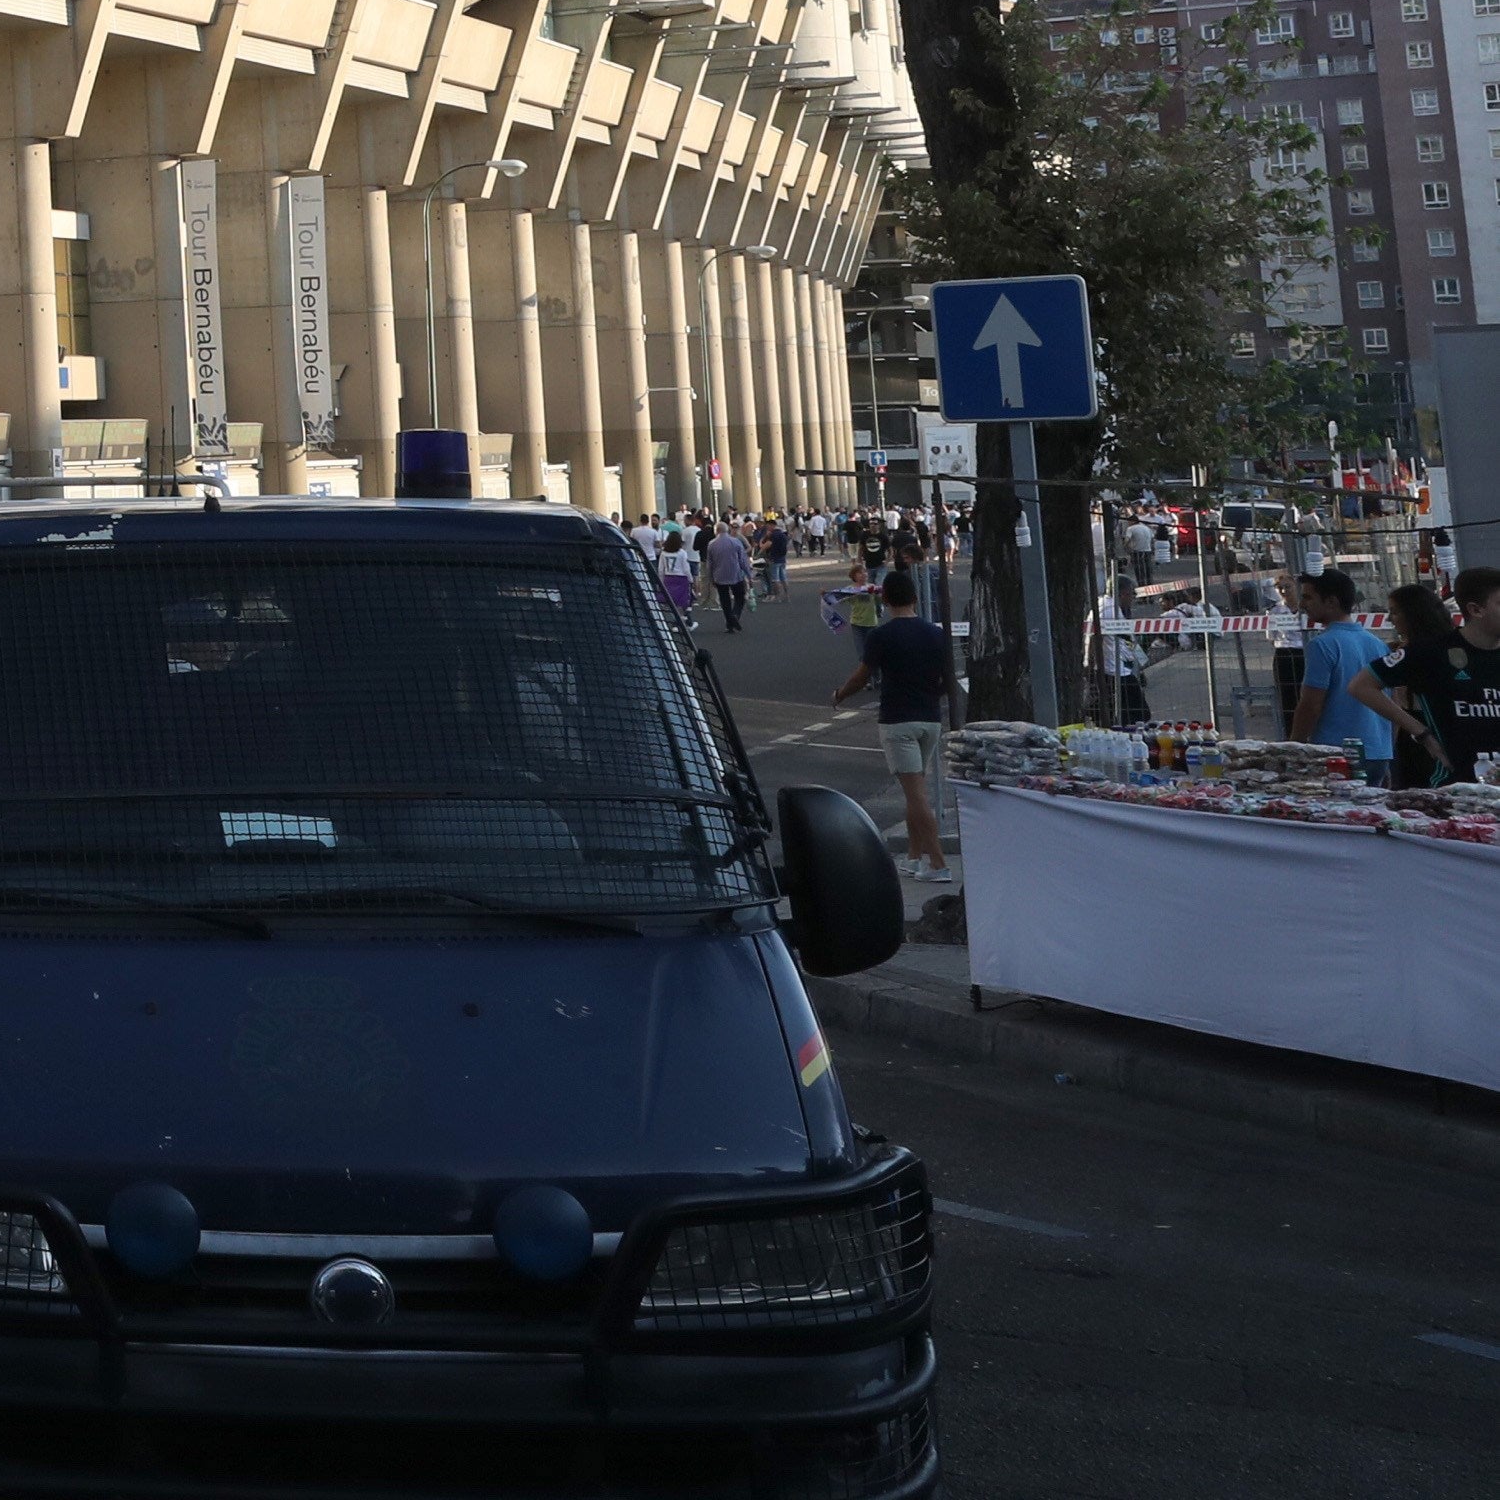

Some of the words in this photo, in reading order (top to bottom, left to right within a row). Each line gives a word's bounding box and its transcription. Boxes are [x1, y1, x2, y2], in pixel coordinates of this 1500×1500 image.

[191, 204, 210, 260] Tour
[298, 216, 319, 269] Tour
[194, 268, 220, 395] Bernabéu
[300, 276, 325, 393] Bernabéu
